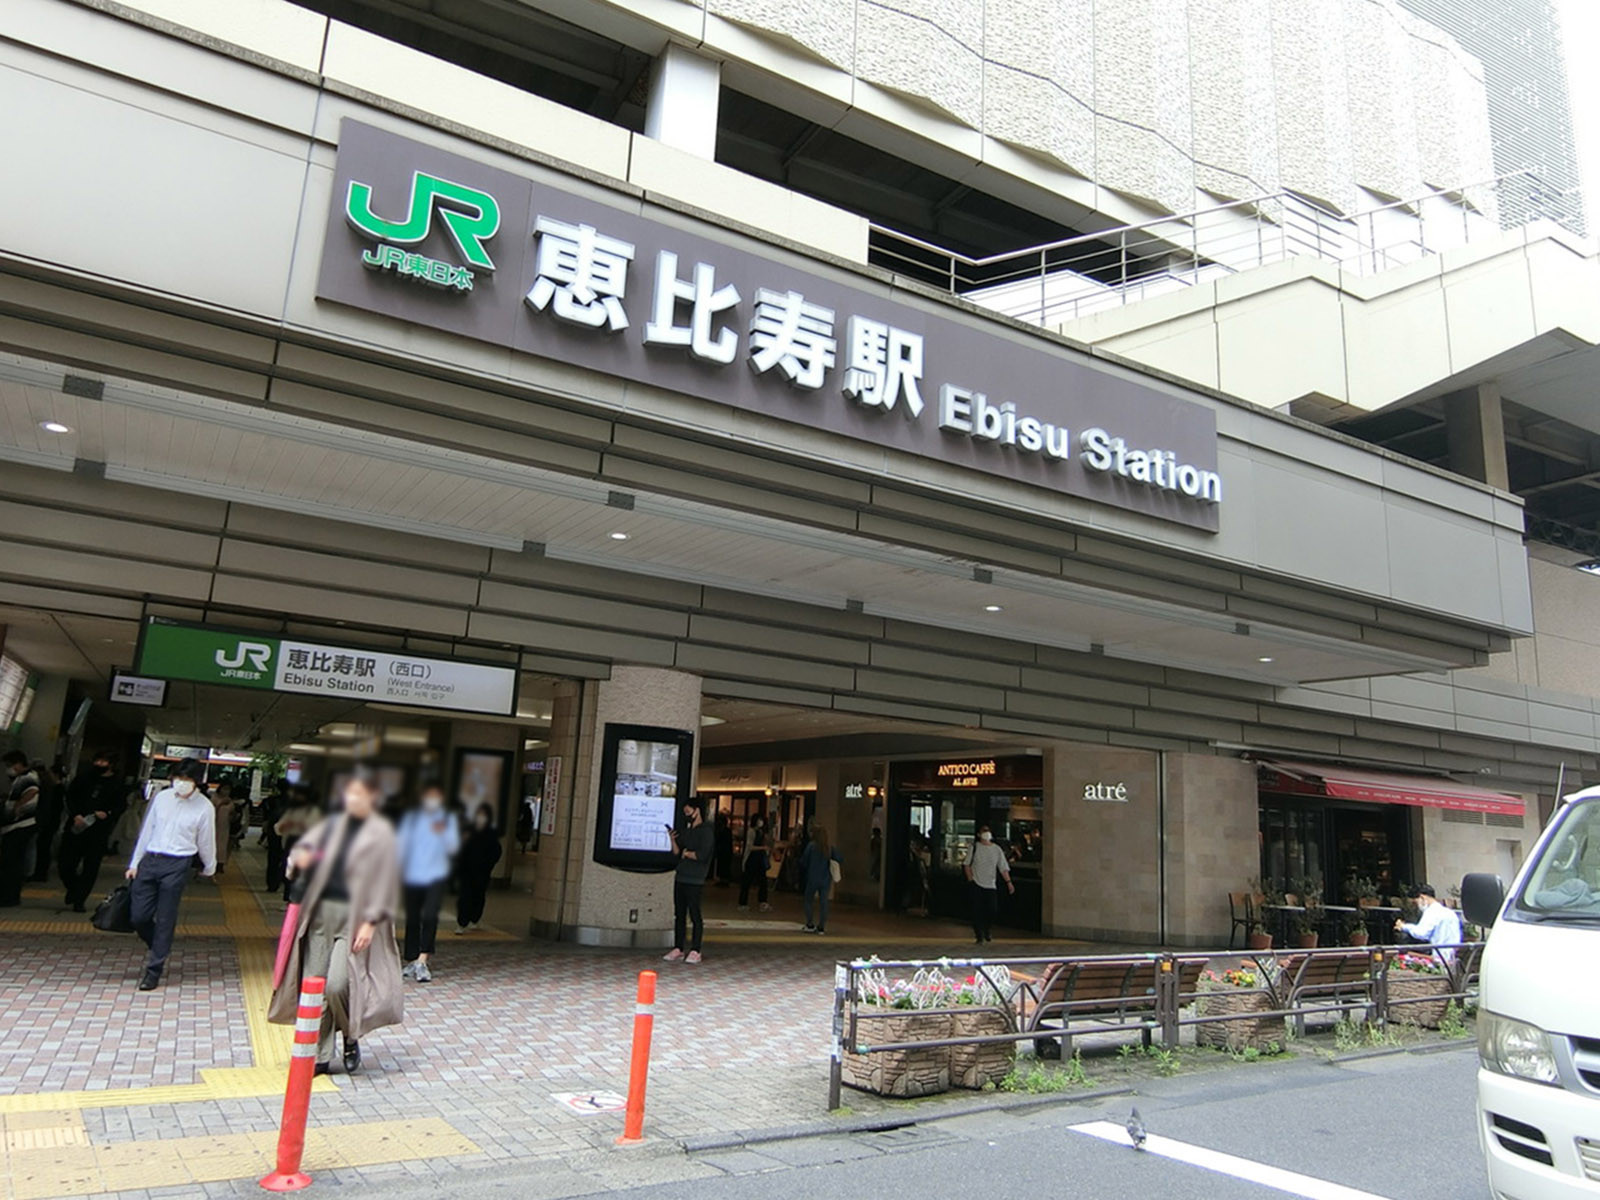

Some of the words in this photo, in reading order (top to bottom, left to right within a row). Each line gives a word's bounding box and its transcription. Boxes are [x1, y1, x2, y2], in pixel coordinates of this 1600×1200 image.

[346, 170, 501, 271] JR
[362, 243, 475, 290] JR東日本
[525, 213, 925, 419] 恵比寿駅
[939, 383, 1071, 461] Ebisu
[1080, 427, 1223, 504] Station
[215, 641, 271, 672] JR
[286, 649, 376, 678] 恵比寿駅
[220, 669, 262, 681] JR東日本
[284, 672, 323, 688] Ebisu
[327, 677, 375, 693] Station
[938, 764, 969, 775] ANTICO
[1084, 782, 1127, 800] atré
